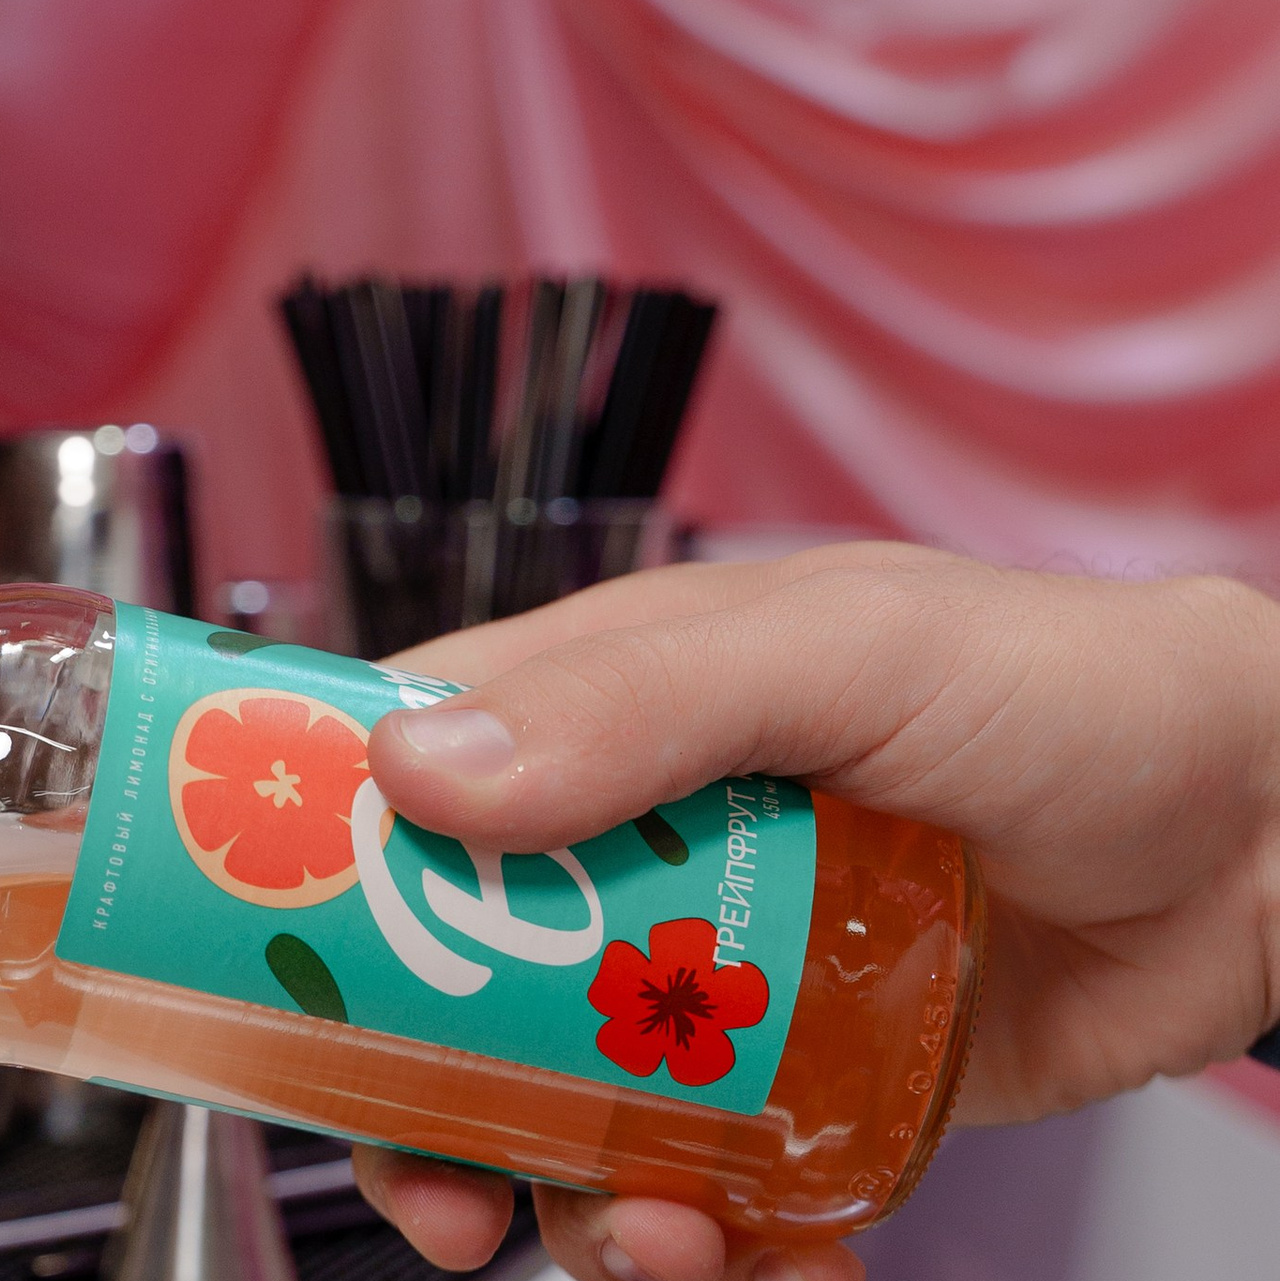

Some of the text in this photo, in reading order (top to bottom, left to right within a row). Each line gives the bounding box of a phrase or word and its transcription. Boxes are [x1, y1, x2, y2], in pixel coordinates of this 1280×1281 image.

[93, 811, 134, 930] КРАФТОВЫЙ
[124, 713, 154, 800] ЛИМОНАД
[140, 693, 155, 703] С
[712, 786, 758, 968] ГРЕЙПФРУТ
[762, 796, 781, 819] 450
